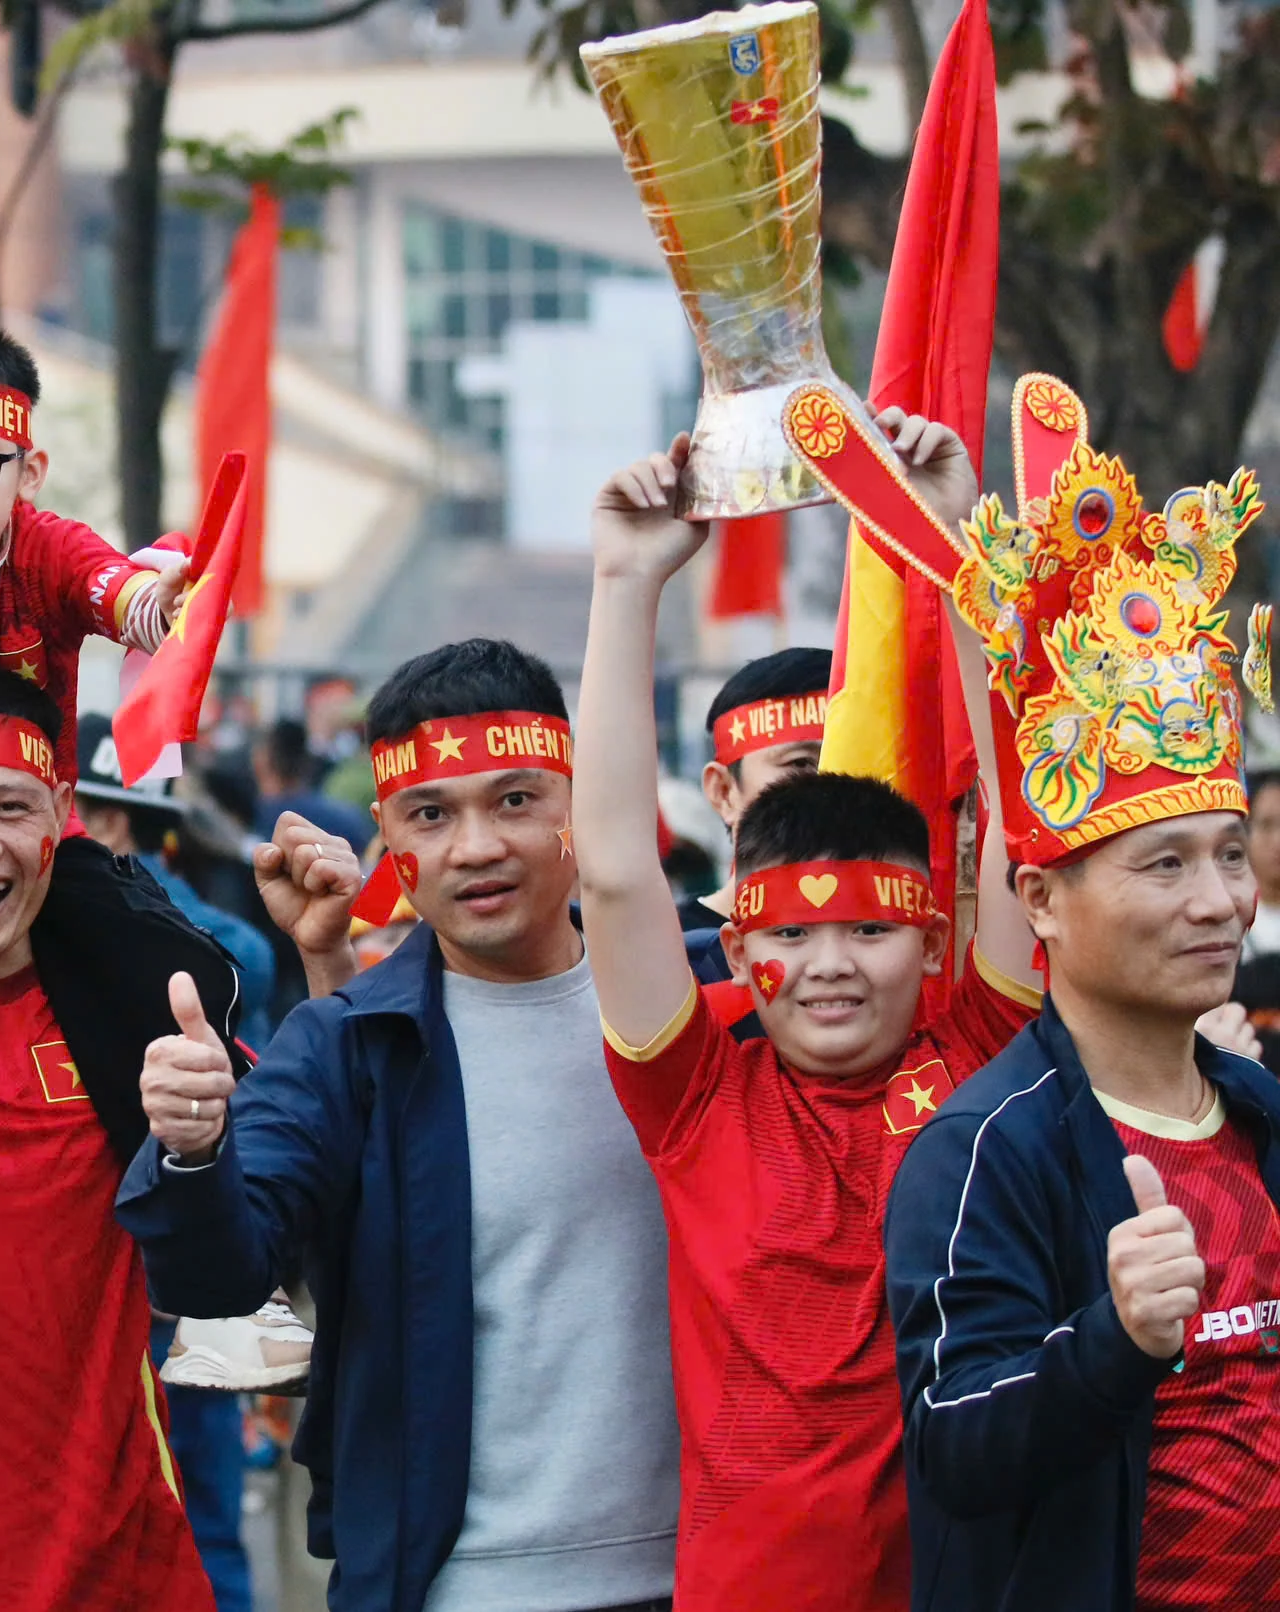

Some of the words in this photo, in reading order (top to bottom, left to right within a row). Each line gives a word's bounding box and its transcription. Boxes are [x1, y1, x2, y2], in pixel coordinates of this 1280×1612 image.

[748, 698, 785, 738] VIỆT
[19, 731, 53, 777] VIỆT
[375, 741, 417, 784] NAM
[486, 717, 560, 760] CHIẾN
[874, 874, 923, 918] VIỆT
